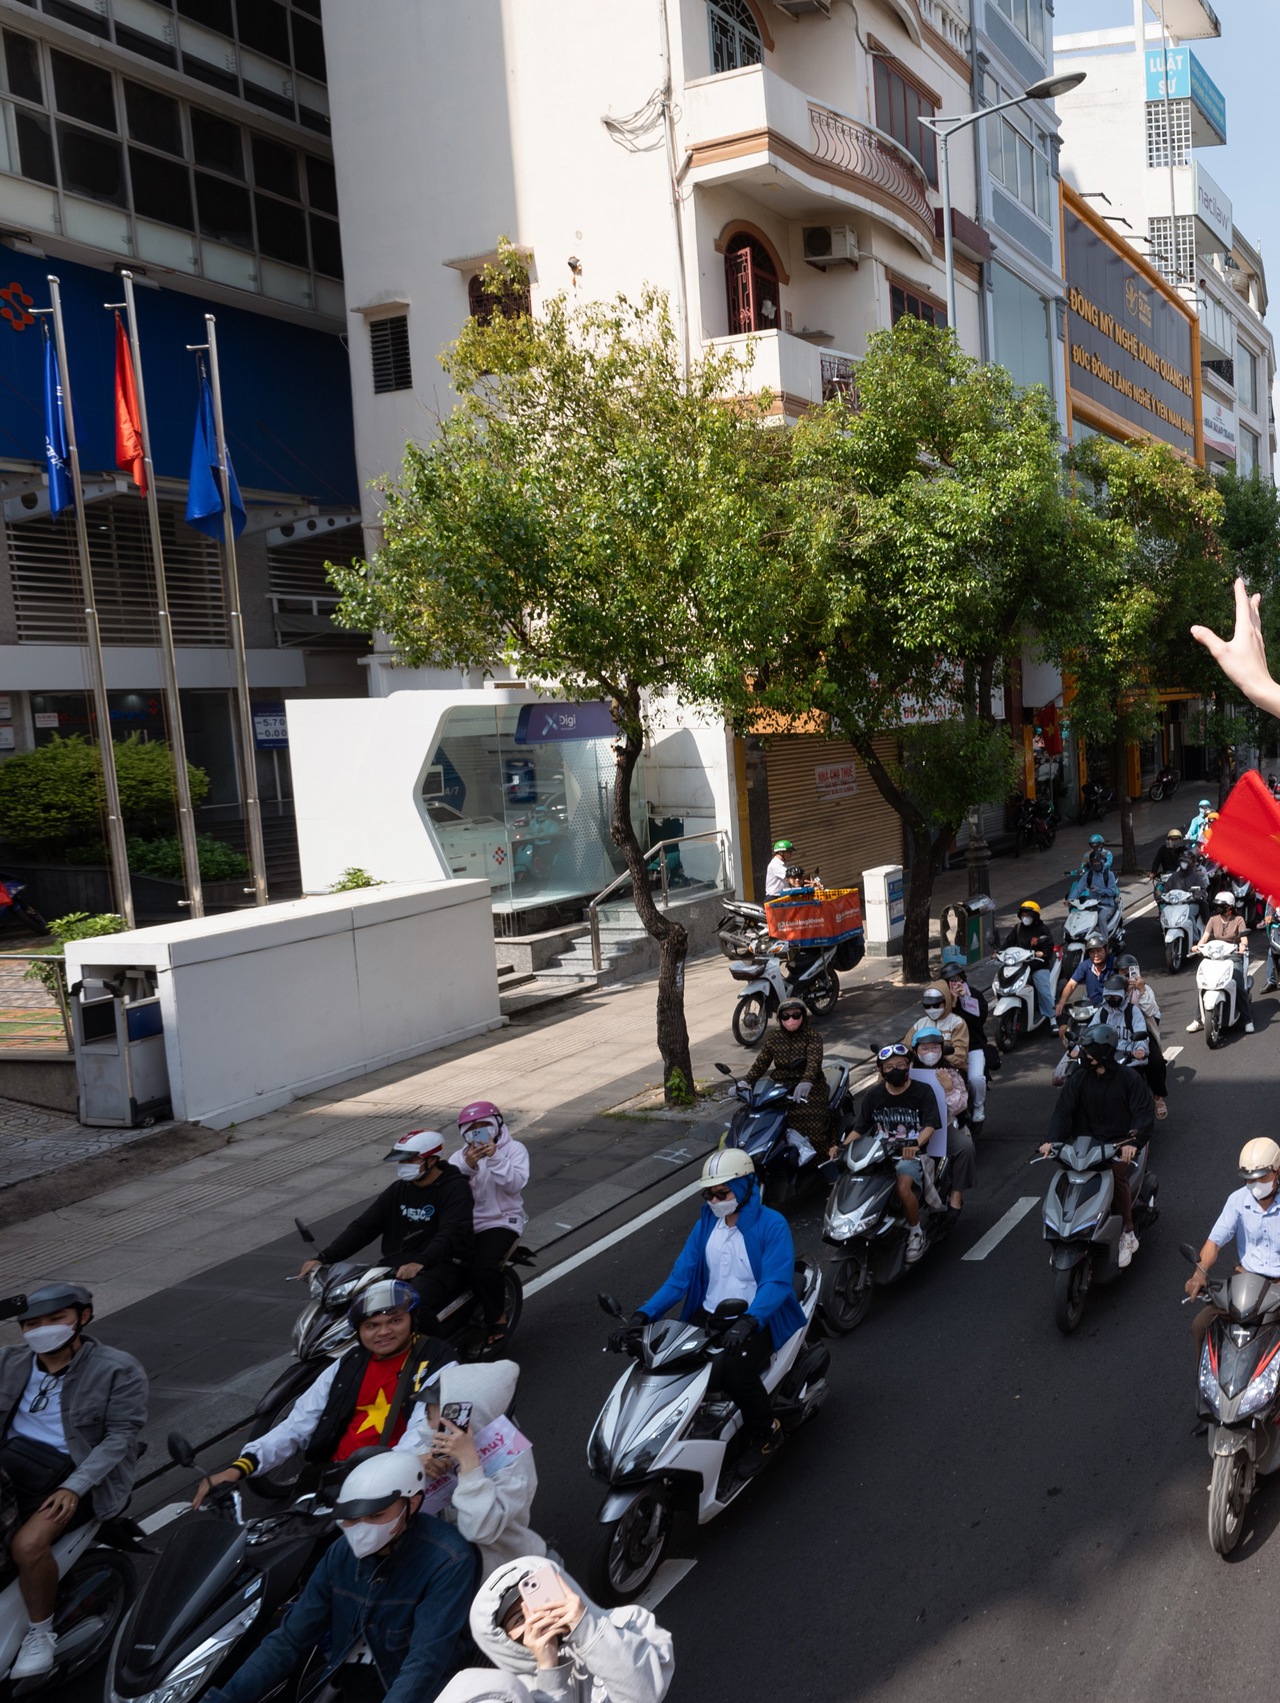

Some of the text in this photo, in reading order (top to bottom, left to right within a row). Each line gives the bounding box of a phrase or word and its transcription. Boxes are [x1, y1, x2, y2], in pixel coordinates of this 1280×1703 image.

[1069, 287, 1098, 327] ĐỒNG
[1098, 311, 1113, 338] MỸ
[1114, 322, 1138, 360] NGHỆ
[1139, 341, 1160, 372] DUNG
[1160, 358, 1183, 393] QUANG
[1071, 344, 1091, 371] ĐÚC
[1113, 370, 1133, 399] LÀNG
[559, 714, 576, 727] Digi
